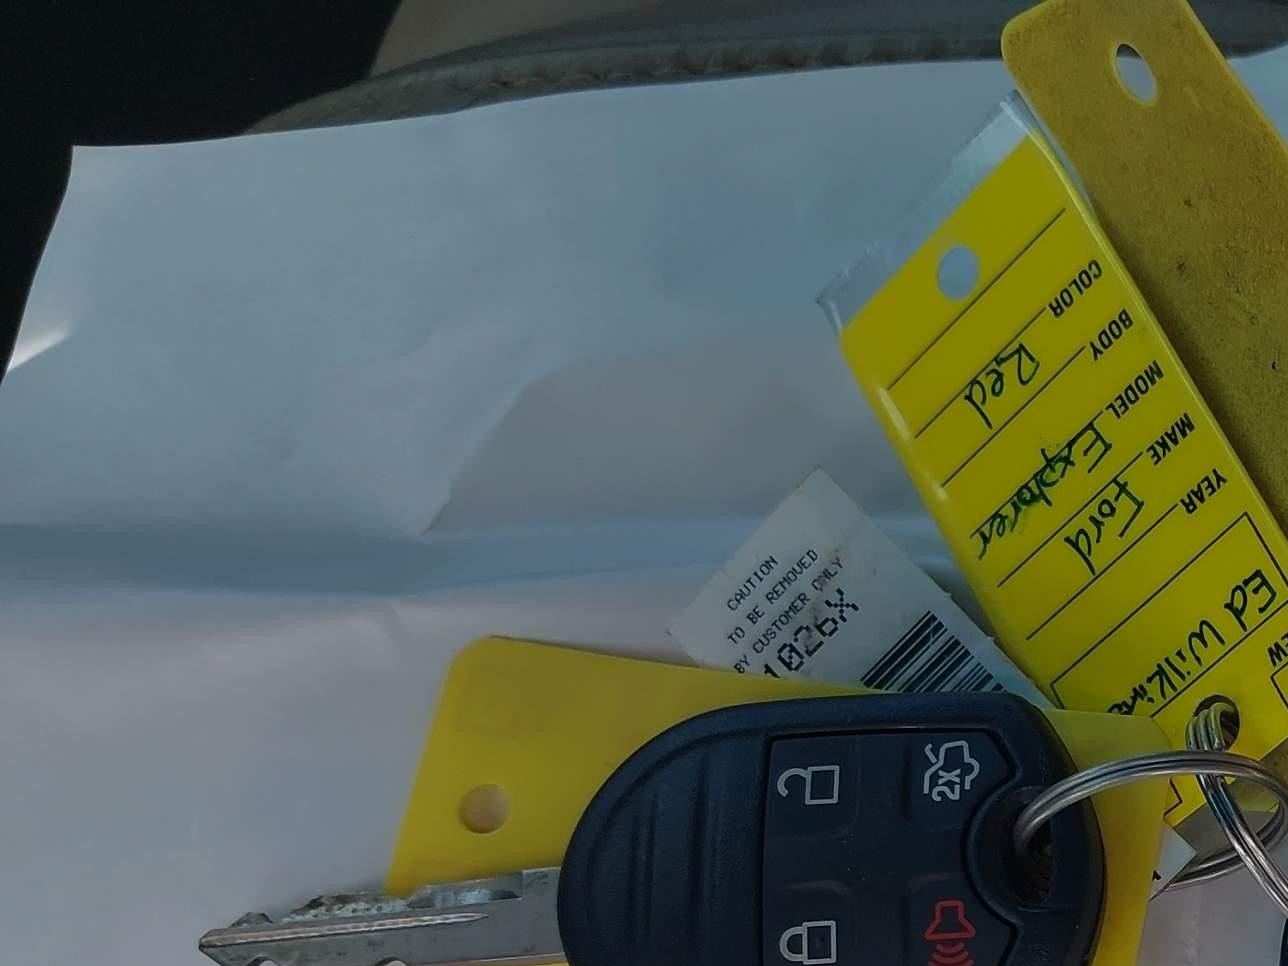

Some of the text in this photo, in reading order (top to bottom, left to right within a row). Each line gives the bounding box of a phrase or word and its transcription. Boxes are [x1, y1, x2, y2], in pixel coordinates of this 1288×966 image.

[1048, 258, 1103, 319] COLOR
[1088, 307, 1134, 362] BODY
[964, 342, 1040, 429] Red
[1106, 359, 1165, 421] MODEL
[1147, 411, 1196, 466] MAKE
[978, 419, 1113, 560] Explorer
[1180, 468, 1228, 515] YEAR
[1063, 477, 1145, 575] Ford
[726, 555, 779, 612] CAUTION
[727, 548, 820, 645] TO BE REMOVED
[1224, 568, 1278, 632] Ed
[733, 556, 844, 675] BY CUSTOMER ONLY
